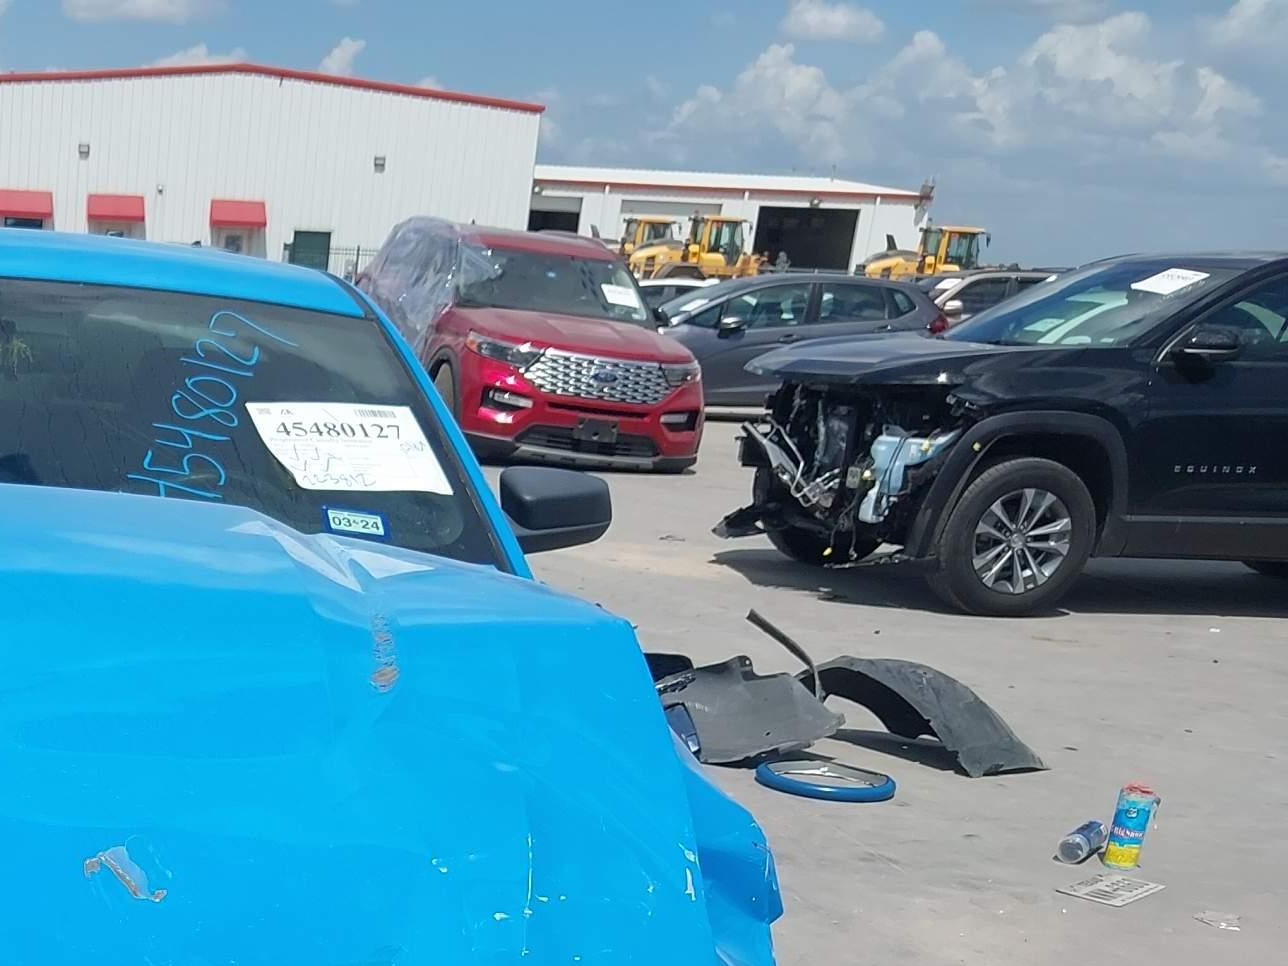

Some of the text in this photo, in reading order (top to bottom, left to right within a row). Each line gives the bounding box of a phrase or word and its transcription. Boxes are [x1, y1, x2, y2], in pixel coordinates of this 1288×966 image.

[126, 310, 300, 499] 45480127
[275, 421, 401, 440] 45480127
[1173, 465, 1257, 474] EQUINOX
